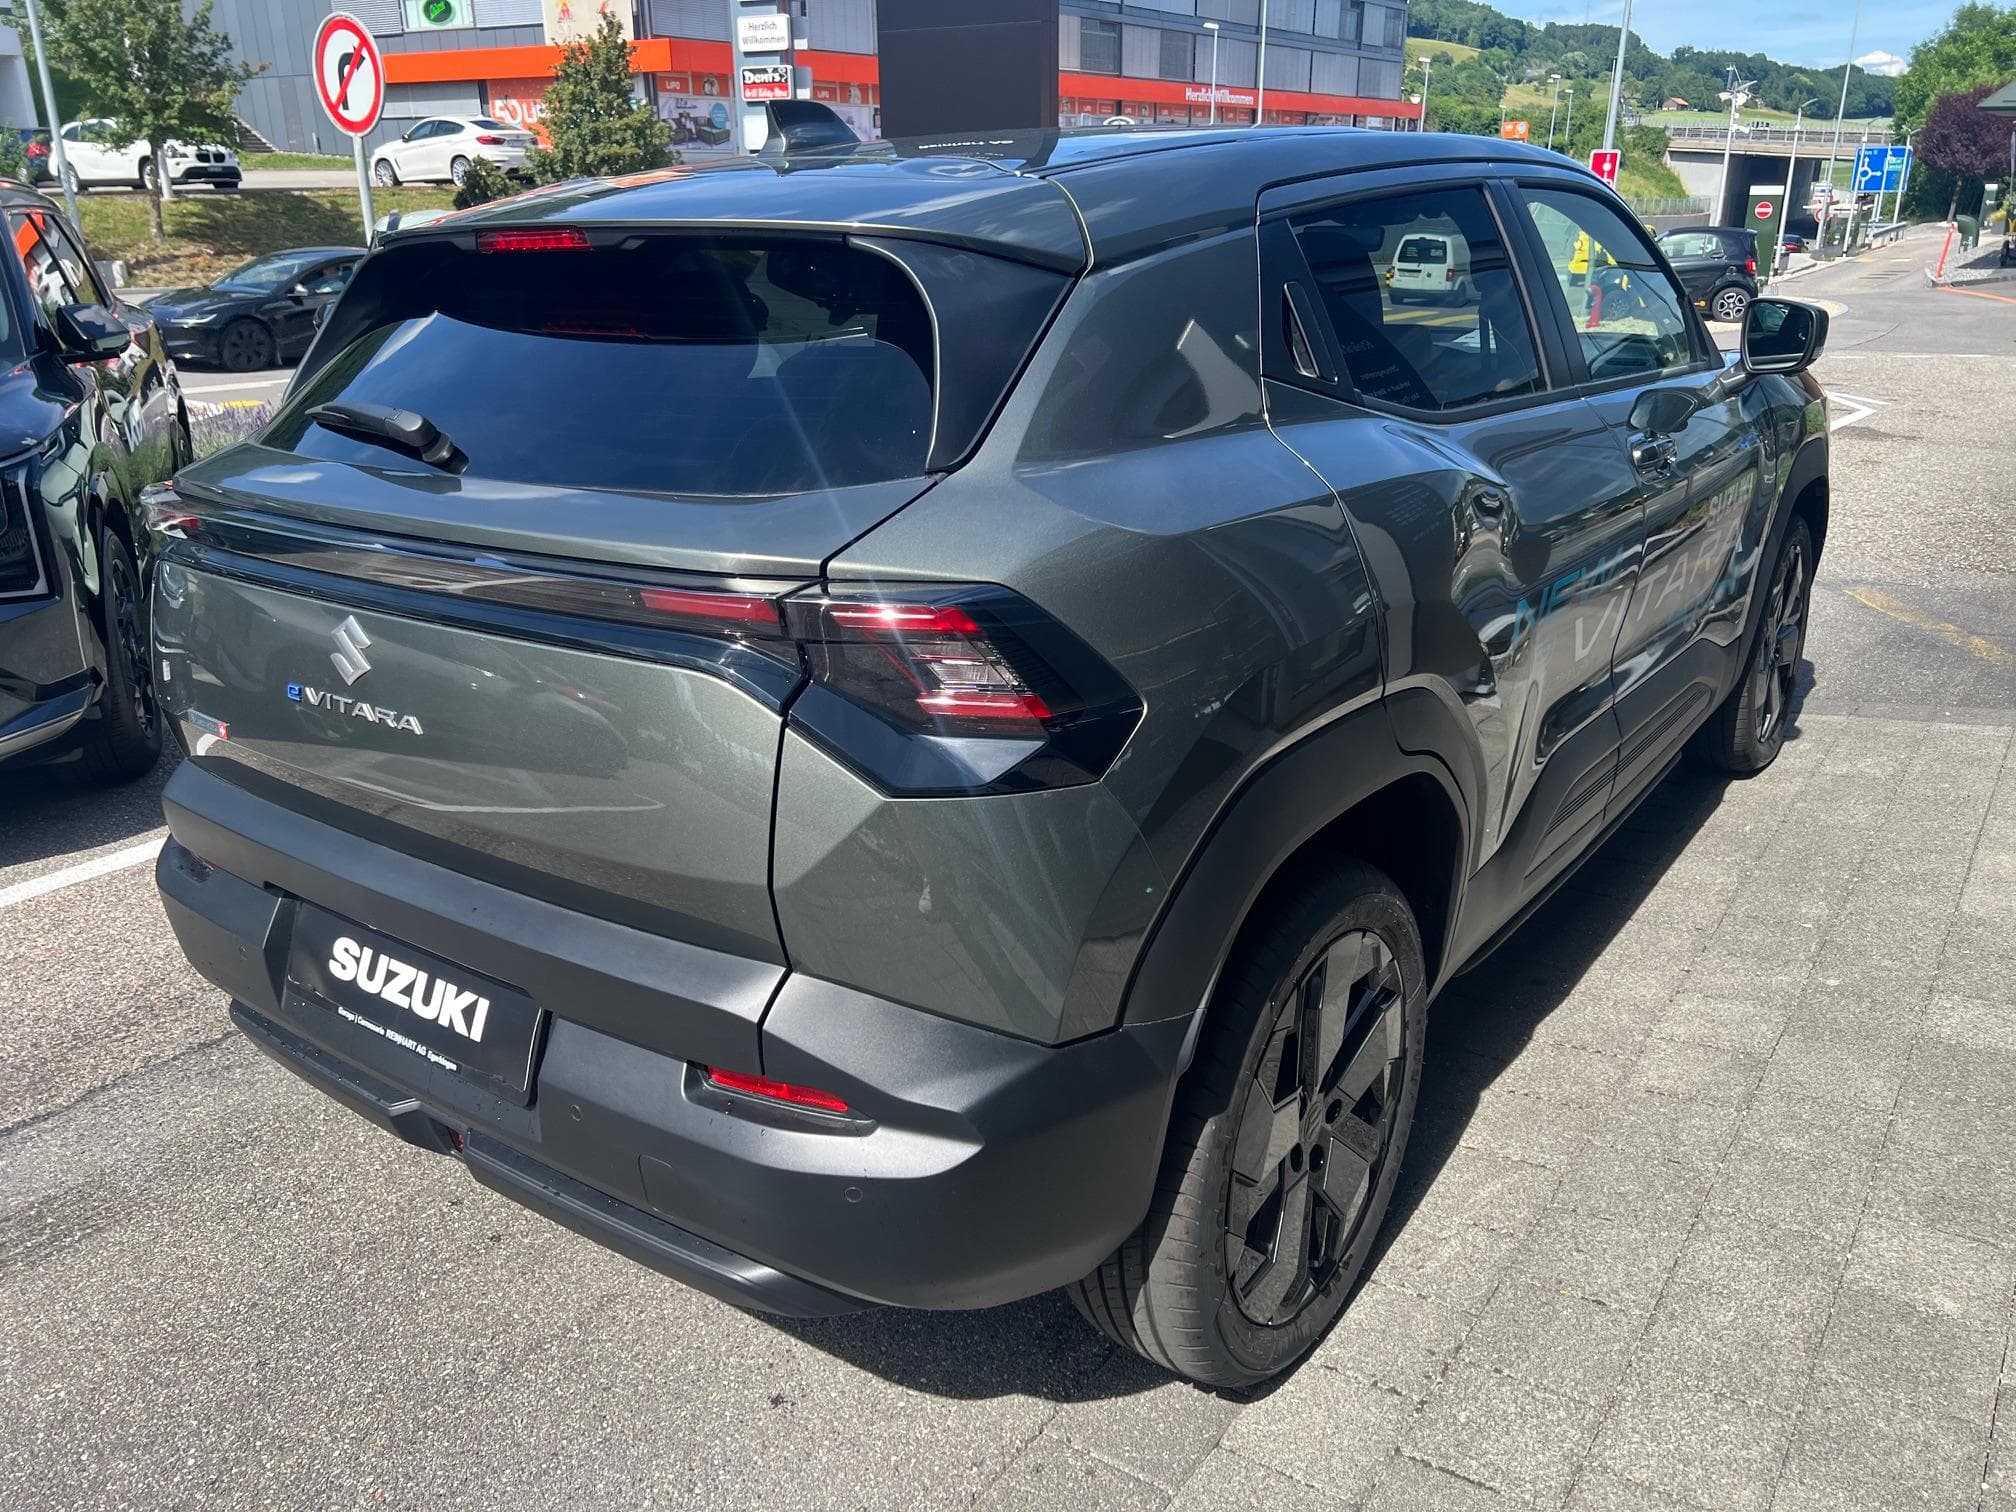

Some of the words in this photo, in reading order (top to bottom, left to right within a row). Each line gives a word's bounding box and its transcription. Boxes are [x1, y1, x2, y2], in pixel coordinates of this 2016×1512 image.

[748, 21, 778, 31] Herzlich
[742, 36, 786, 45] Willkommen
[1511, 544, 1624, 650] NEW
[328, 936, 490, 1043] SUZUKI
[415, 1044, 427, 1056] AG
